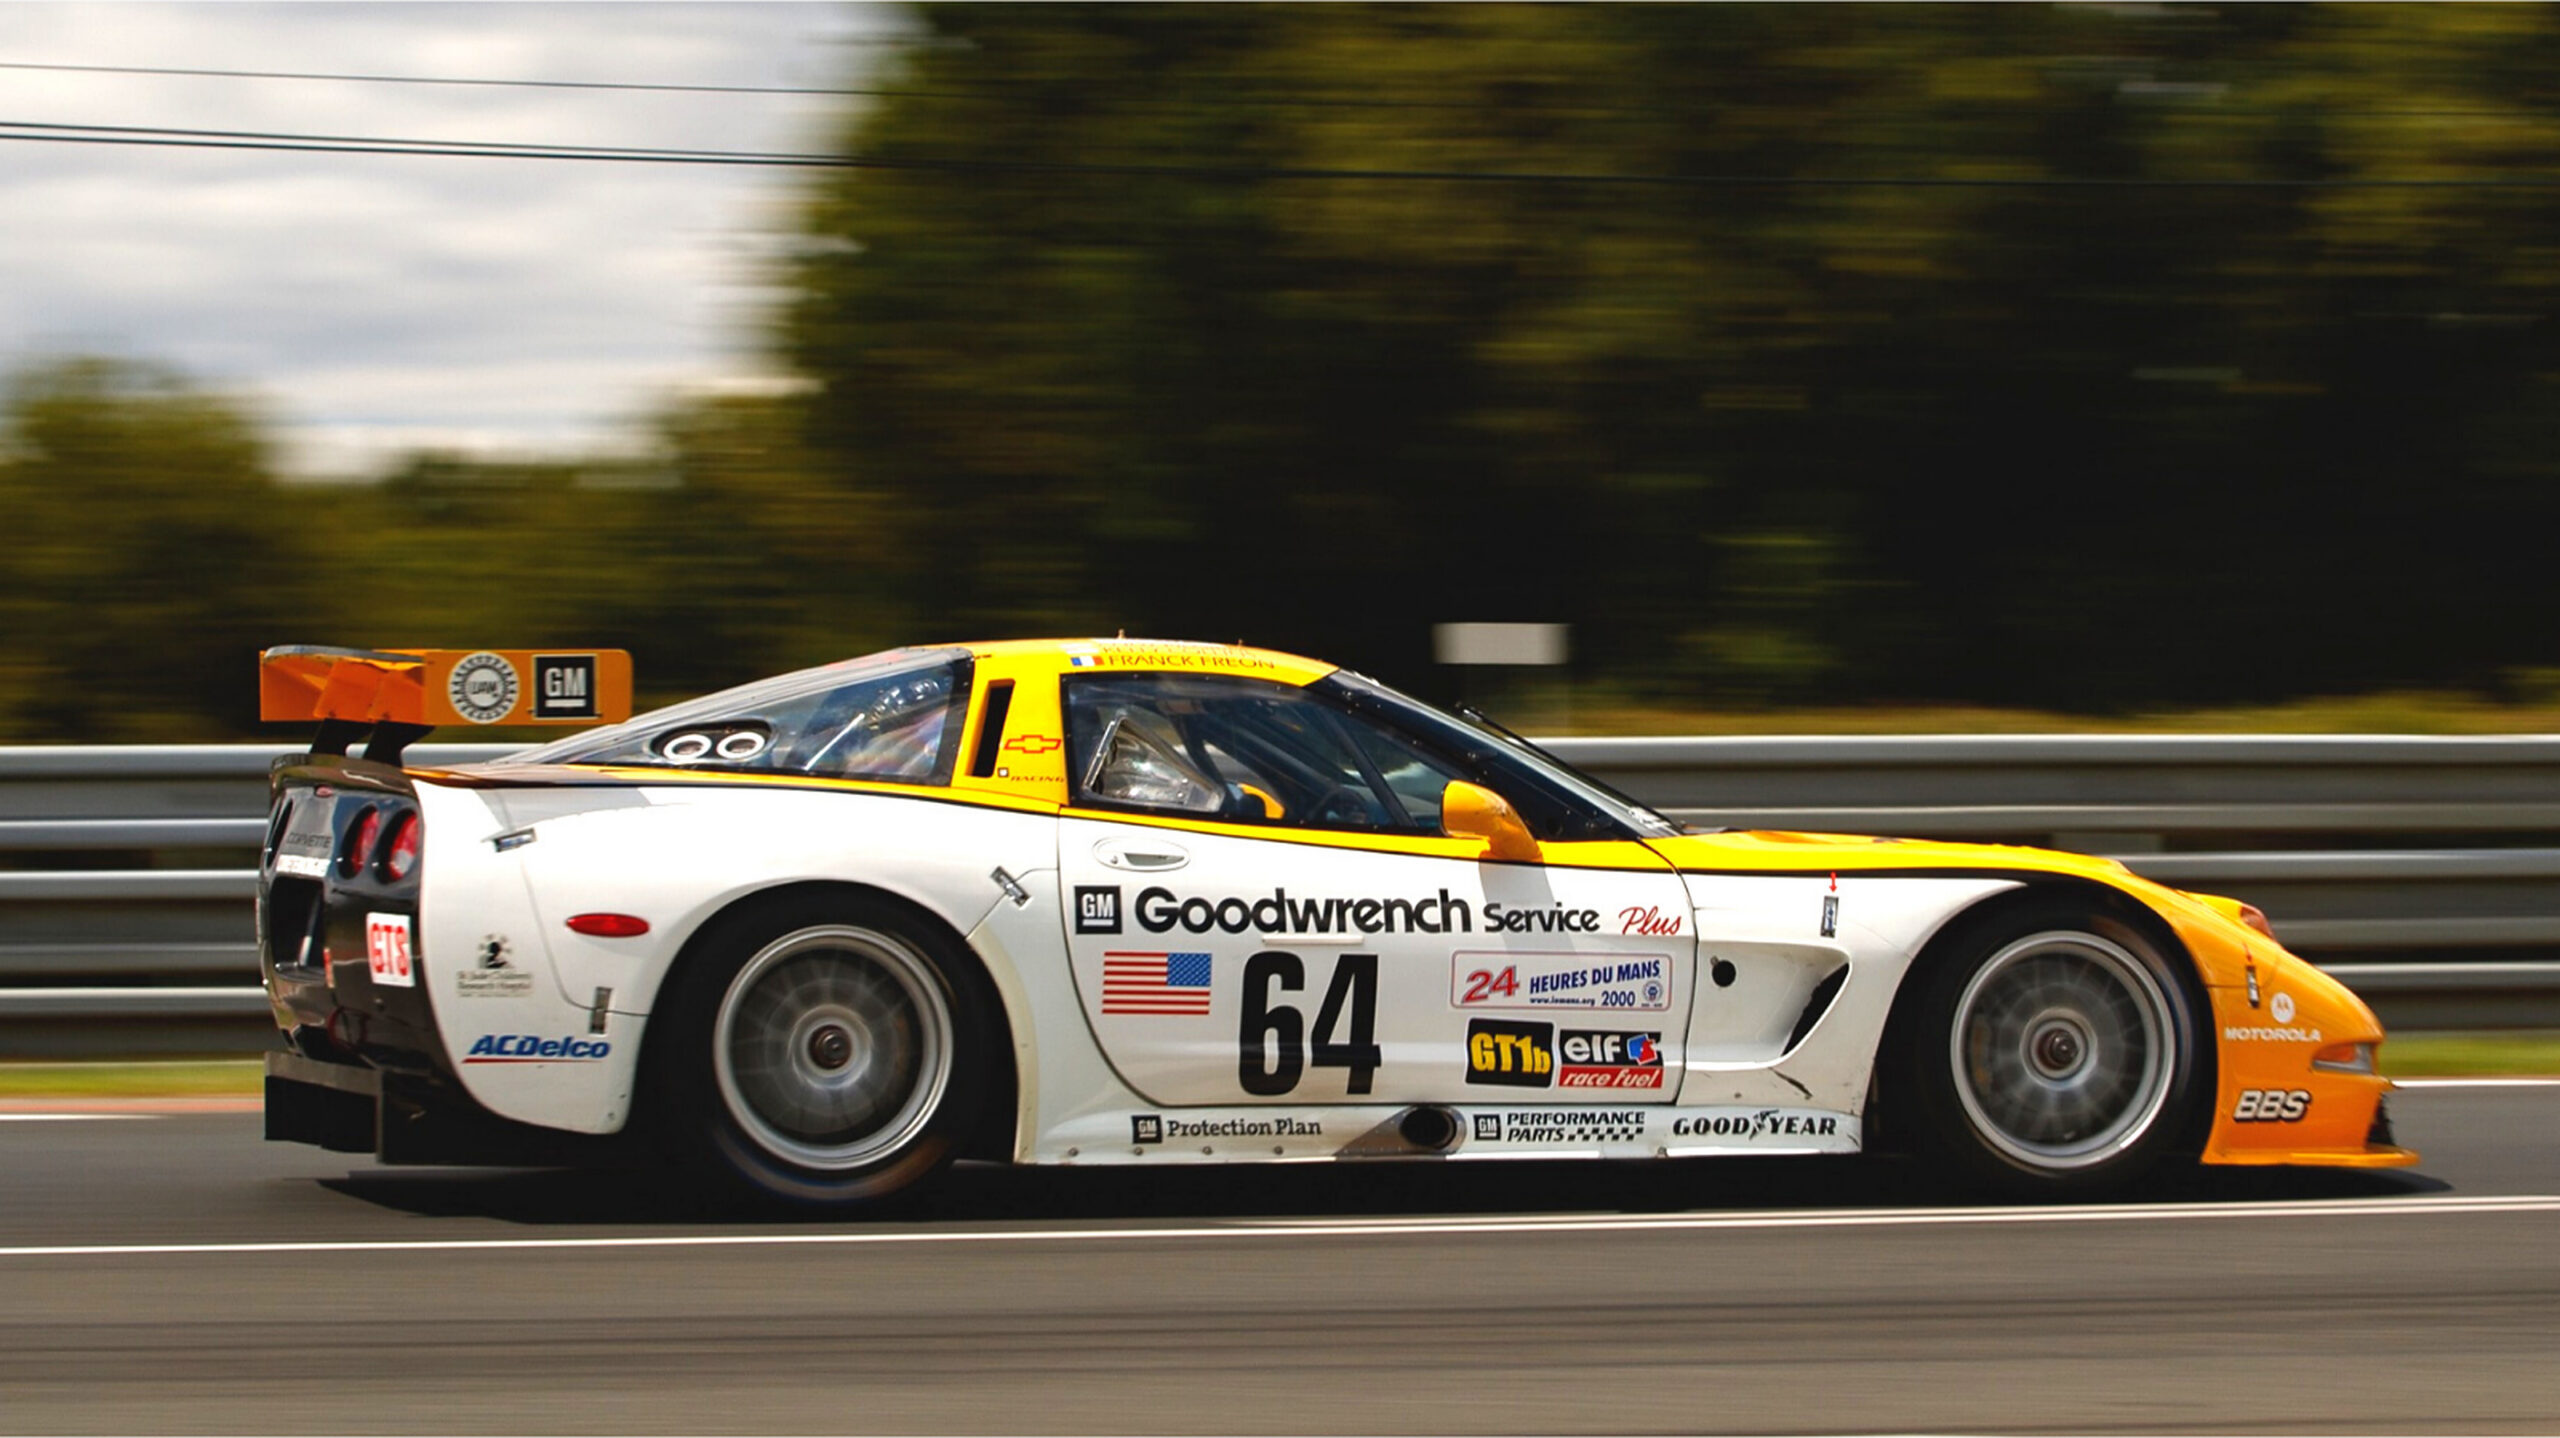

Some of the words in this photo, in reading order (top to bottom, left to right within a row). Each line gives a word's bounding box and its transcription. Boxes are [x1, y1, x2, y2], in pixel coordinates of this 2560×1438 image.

[1108, 655, 1194, 667] FRANCK
[545, 667, 586, 697] GM
[1082, 893, 1114, 917] GM
[1135, 886, 1472, 934] Goodwrench
[1483, 901, 1600, 933] Service
[1618, 905, 1682, 936] Plus
[1461, 965, 1520, 1004] 24
[1529, 970, 1588, 994] HEURES
[1591, 967, 1613, 985] DU
[1617, 959, 1661, 982] MANS
[1601, 991, 1636, 1007] 2000
[1239, 950, 1382, 1096] 64
[2224, 1027, 2322, 1043] MOTOROLA
[468, 1035, 611, 1058] ACDelco
[1470, 1032, 1551, 1075] GT1b
[1564, 1034, 1621, 1063] elf
[1563, 1069, 1609, 1086] race
[1612, 1068, 1660, 1086] fuel
[2233, 1088, 2312, 1122] BBS
[1138, 1120, 1158, 1133] GM
[1167, 1118, 1274, 1138] Protection
[1275, 1118, 1322, 1136] Plan
[1478, 1118, 1498, 1132] GM
[1507, 1111, 1645, 1127] PERFORMANCE
[1507, 1127, 1564, 1142] PARTS
